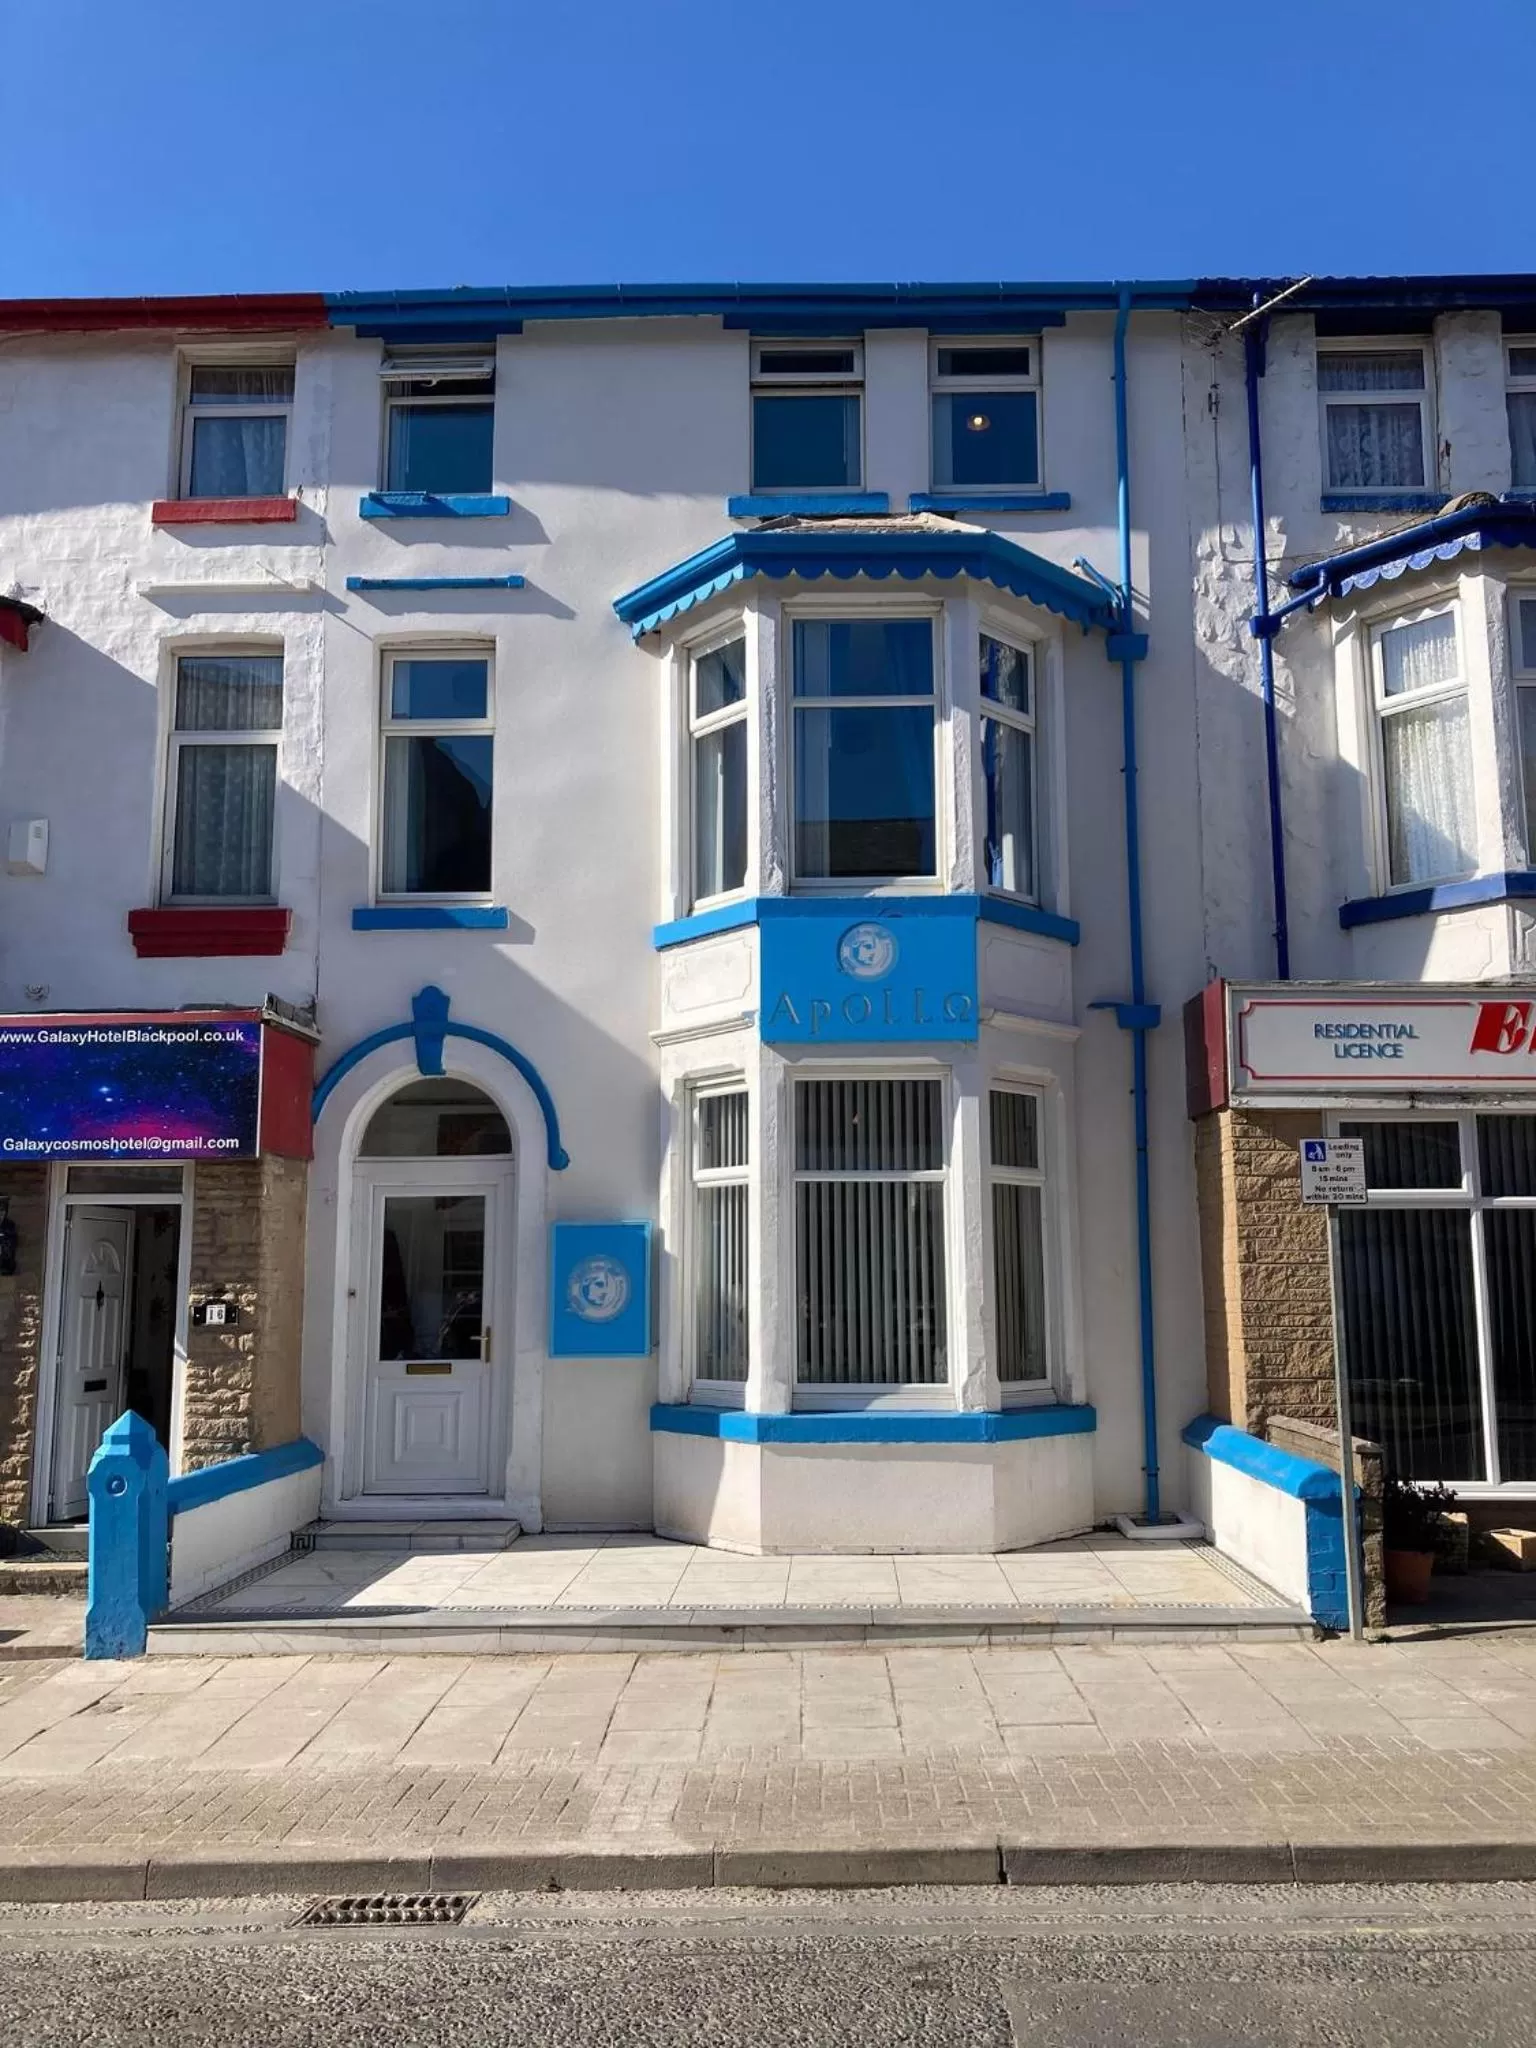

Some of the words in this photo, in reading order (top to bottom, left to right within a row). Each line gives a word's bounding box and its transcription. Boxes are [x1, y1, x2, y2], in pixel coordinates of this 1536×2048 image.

[0, 1028, 245, 1045] www.GalaxyHotelBlackpool.co.uk
[1314, 1023, 1419, 1039] RESIDENTIAL
[1470, 1002, 1536, 1055] E
[1334, 1043, 1403, 1058] LICENCE
[3, 1136, 240, 1153] Galaxycosmoshotel@gmail.com
[209, 1309, 223, 1320] 16
